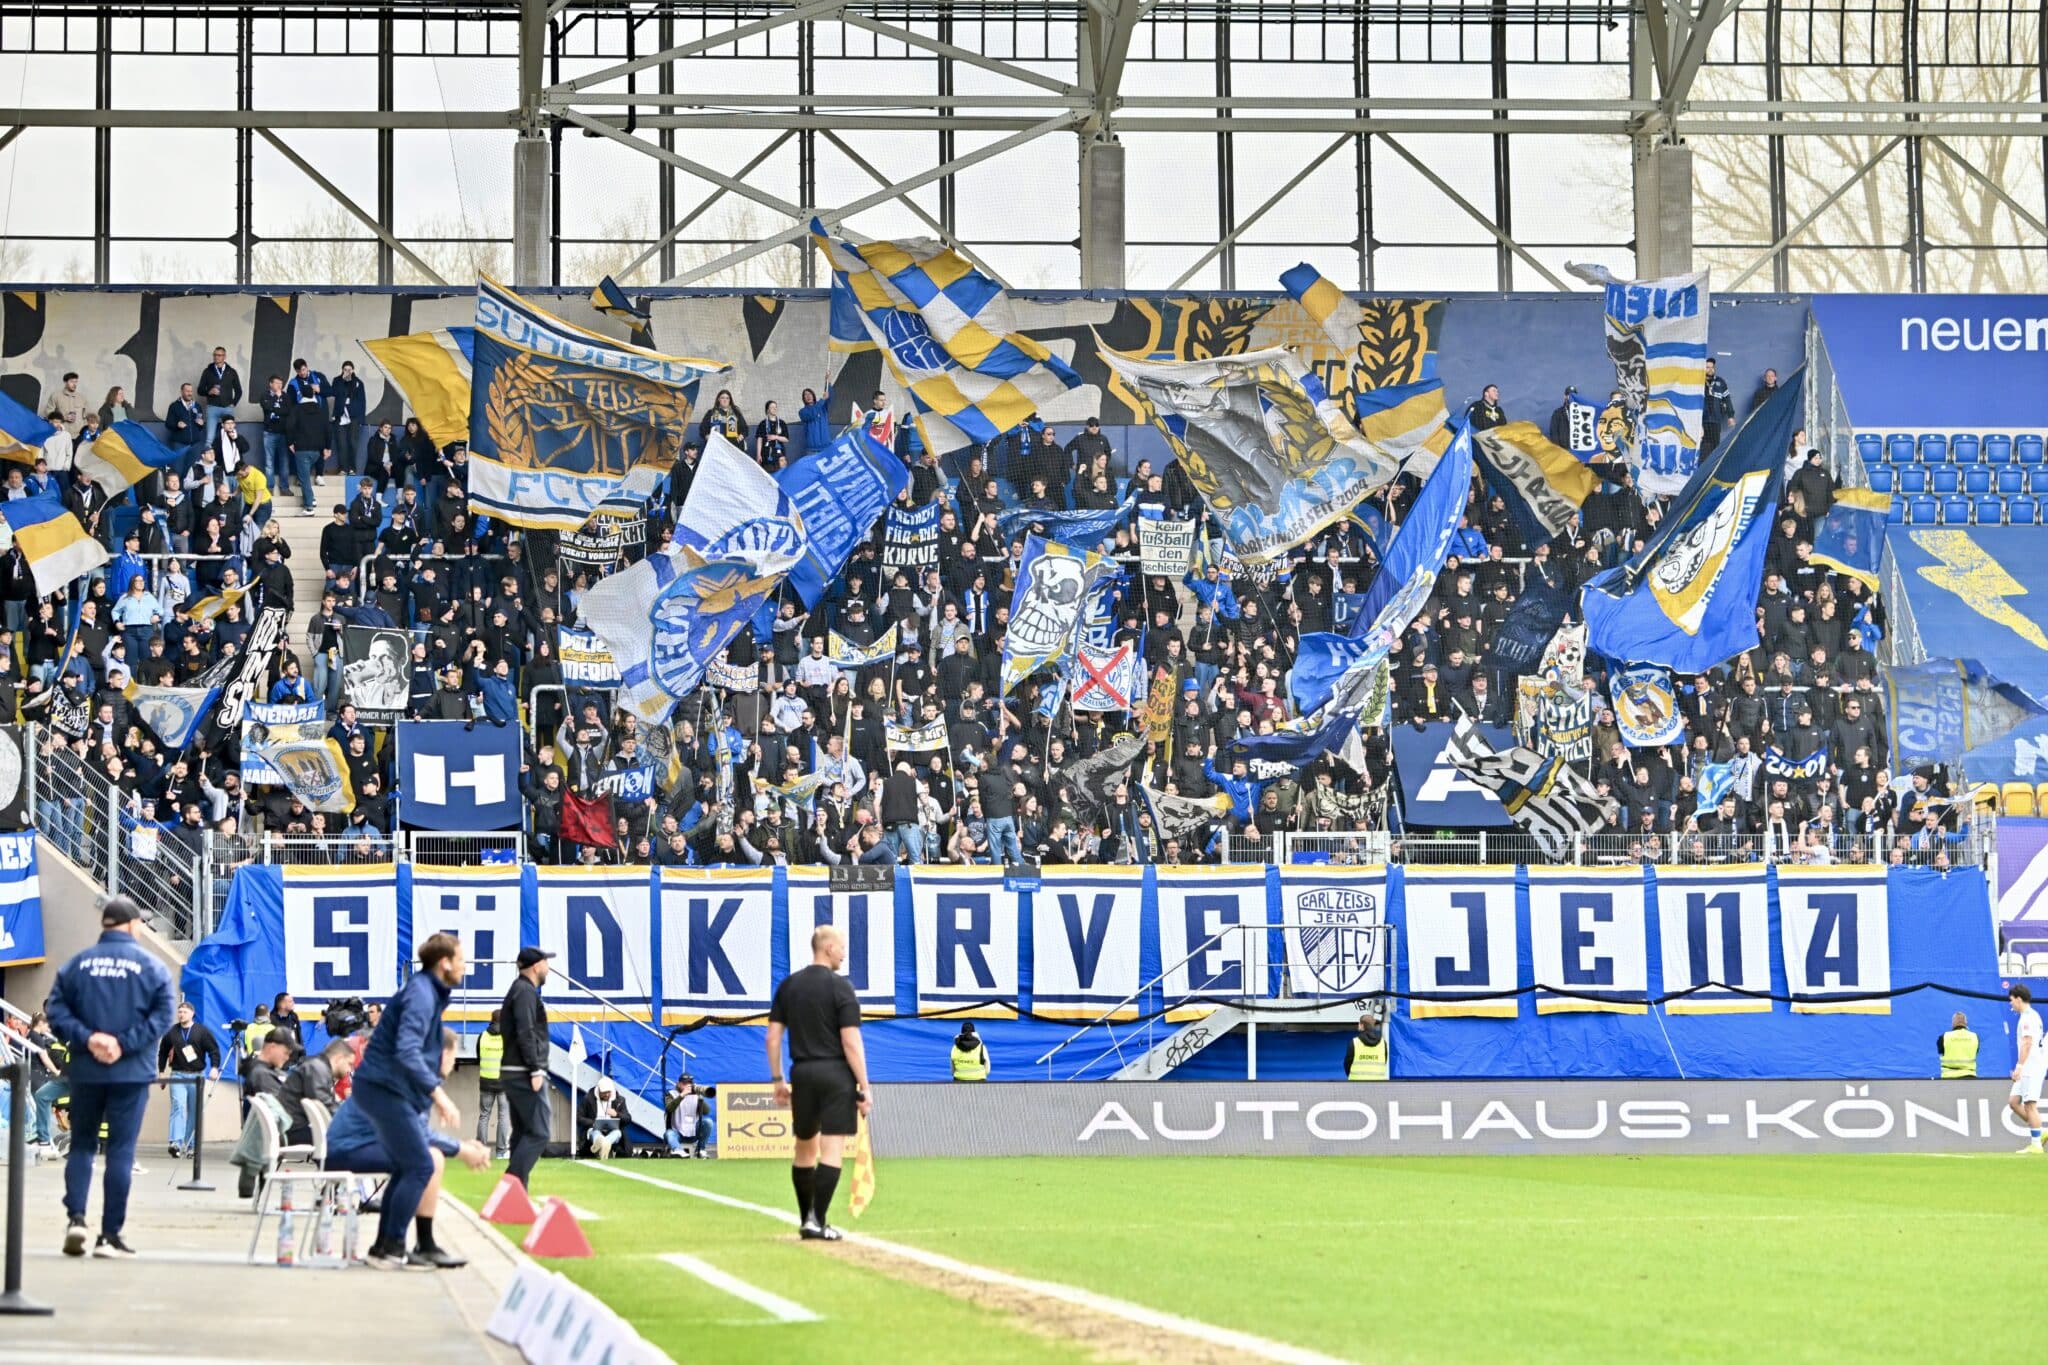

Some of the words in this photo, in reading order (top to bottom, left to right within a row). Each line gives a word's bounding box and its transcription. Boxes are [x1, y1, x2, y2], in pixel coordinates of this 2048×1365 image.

[1306, 500, 1334, 524] SEIT
[1337, 478, 1368, 506] 2004
[601, 522, 646, 545] NCHT
[1155, 522, 1183, 532] kein
[560, 546, 587, 558] UGEND
[1158, 547, 1183, 559] den
[250, 704, 319, 724] WEIMAR
[1302, 891, 1335, 909] CARL
[1336, 891, 1370, 910] ZEISS
[1314, 912, 1359, 924] JENA
[732, 1096, 777, 1106] AUT
[728, 1117, 787, 1138] KÖ
